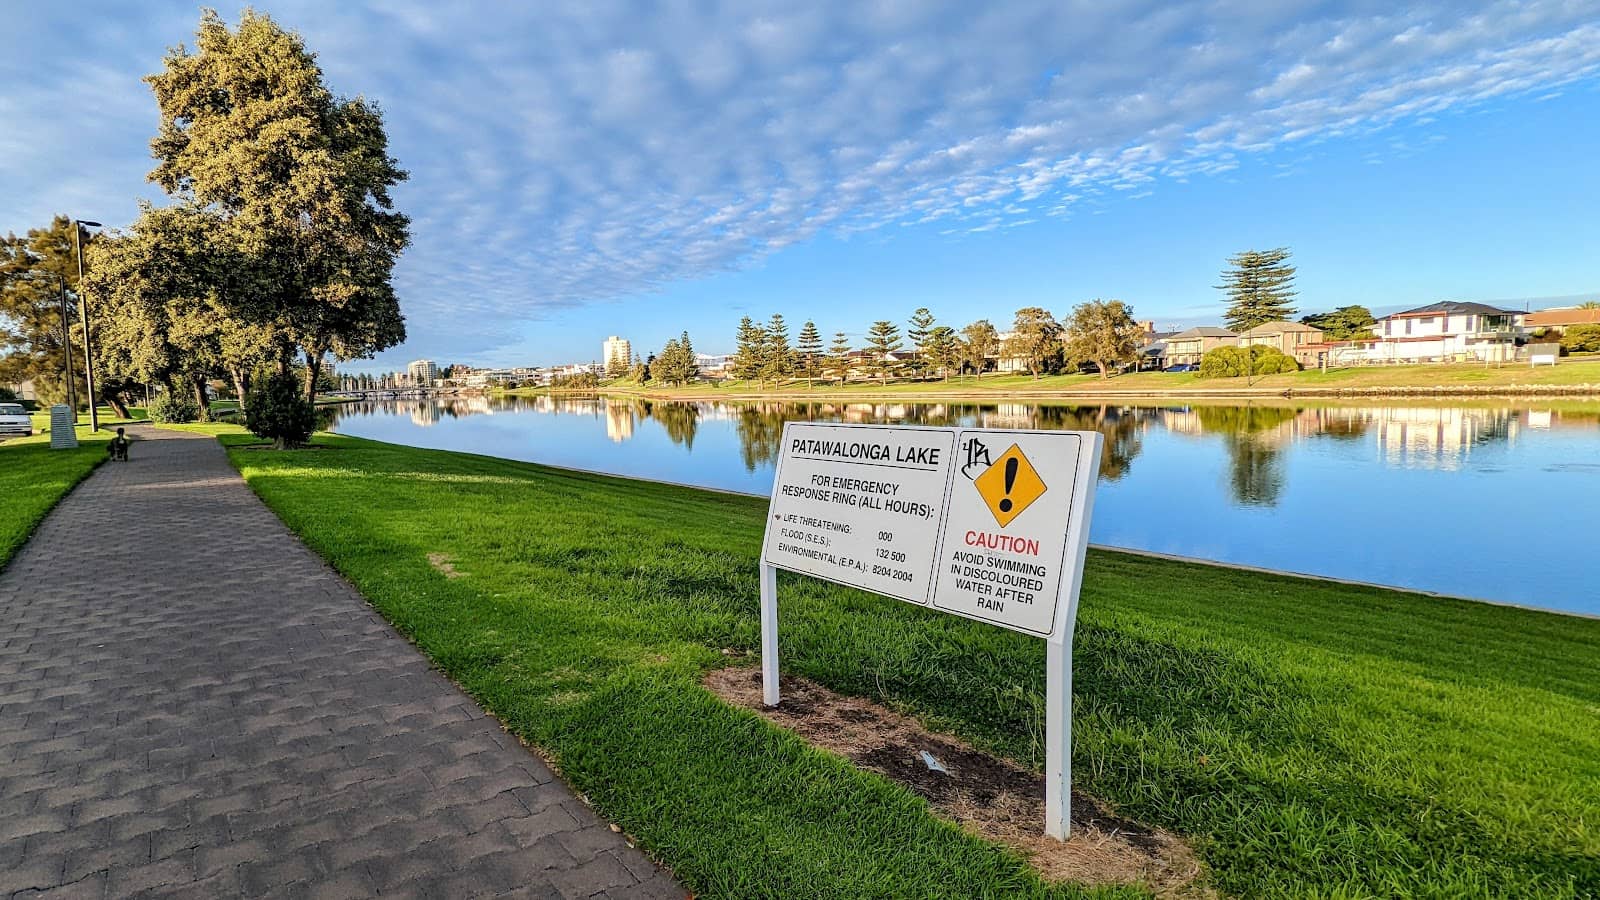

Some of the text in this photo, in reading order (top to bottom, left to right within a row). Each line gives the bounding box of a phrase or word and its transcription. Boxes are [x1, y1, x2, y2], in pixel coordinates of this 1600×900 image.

[792, 440, 940, 465] PATAWALONGA LAKE
[812, 475, 899, 495] FOR EMERGENCY
[782, 485, 935, 520] RESPONSE RING (ALL HOURS):
[784, 514, 892, 541] LIFE THREATENING: 000
[781, 529, 905, 562] FLOOD (S.E.S.): 132 500
[965, 531, 1039, 556] CAUTION
[779, 544, 913, 582] ENVIRONMENTAL (E.P.A.): 8204 2004
[953, 552, 1046, 576] AVOID SWIMMING
[951, 565, 1043, 591] IN DISCOLOURED
[956, 579, 1034, 604] WATER AFTER
[977, 598, 1004, 612] RAIN
